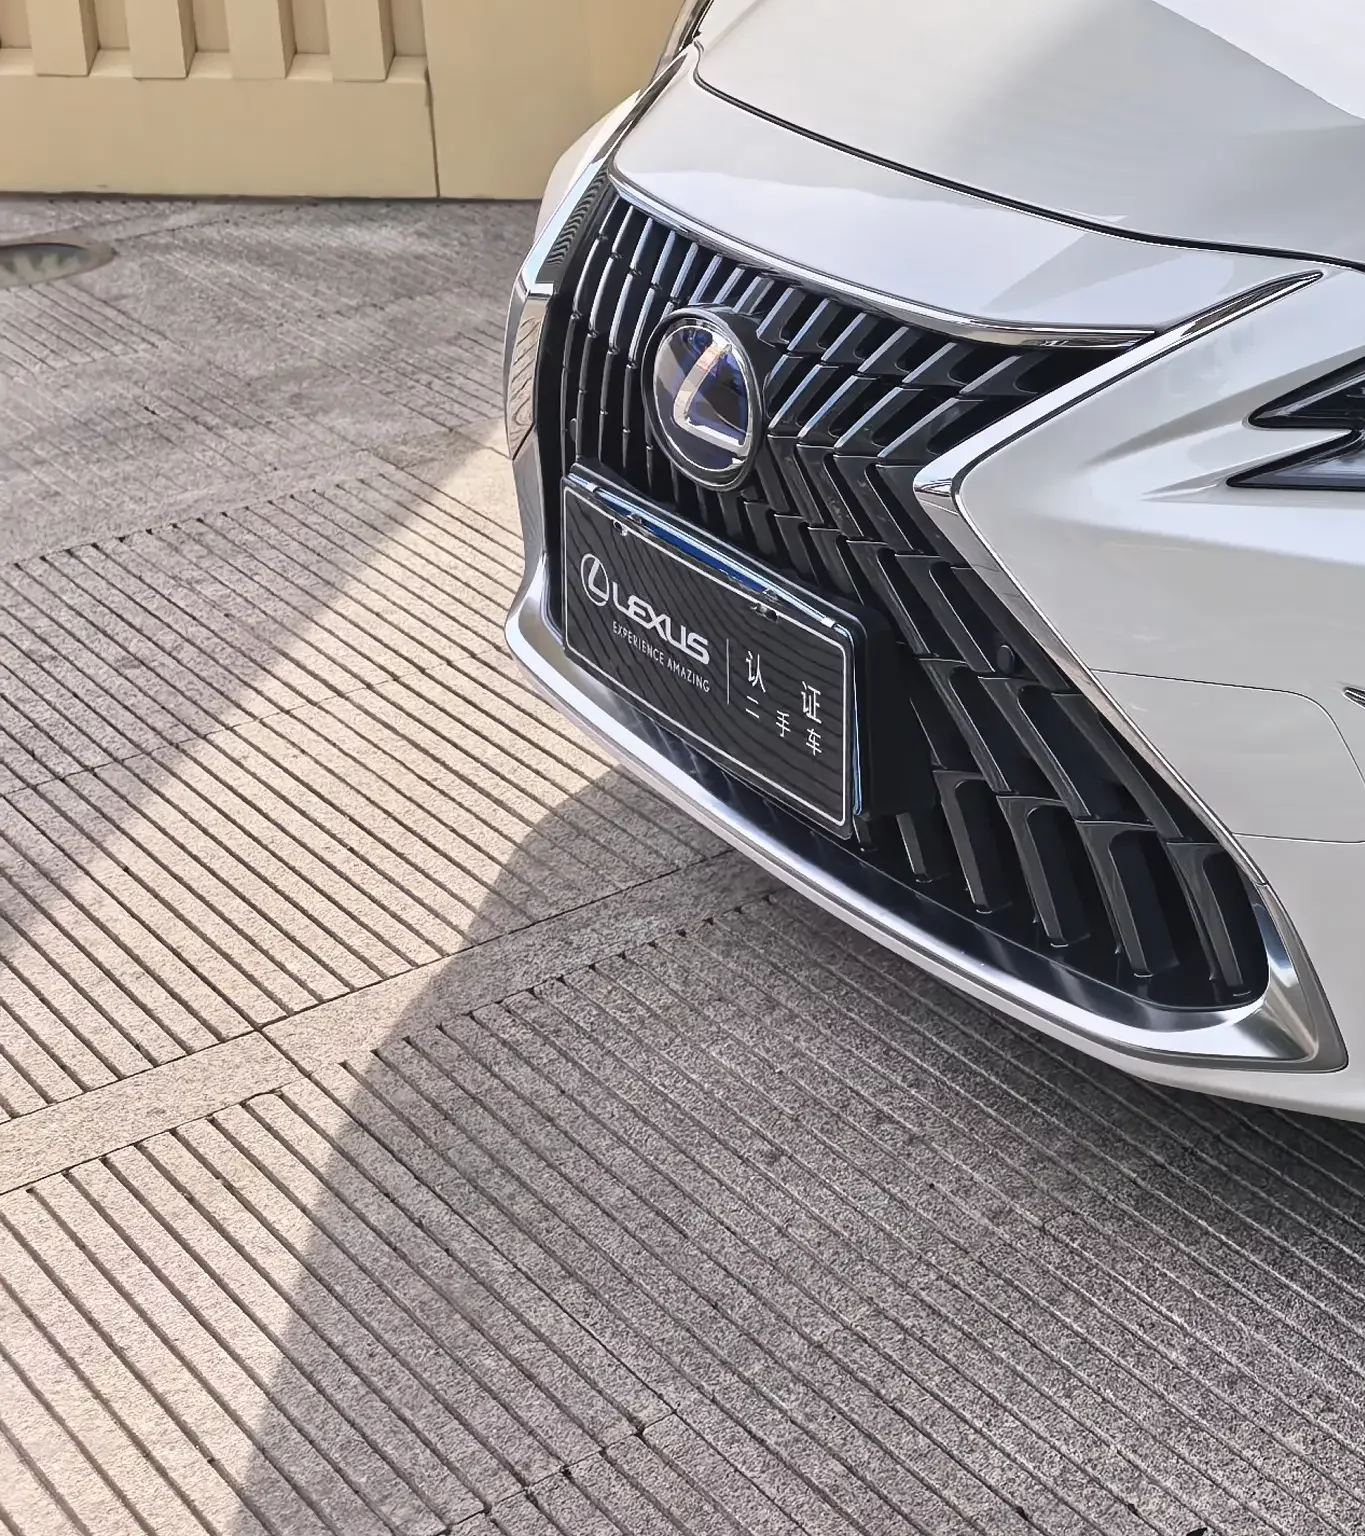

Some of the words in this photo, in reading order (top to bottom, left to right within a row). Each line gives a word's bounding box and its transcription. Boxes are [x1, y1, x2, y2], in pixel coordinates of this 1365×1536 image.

[612, 581, 710, 665] LEXUS
[612, 619, 664, 666] EXPERIENCE
[667, 658, 710, 693] AMAZING
